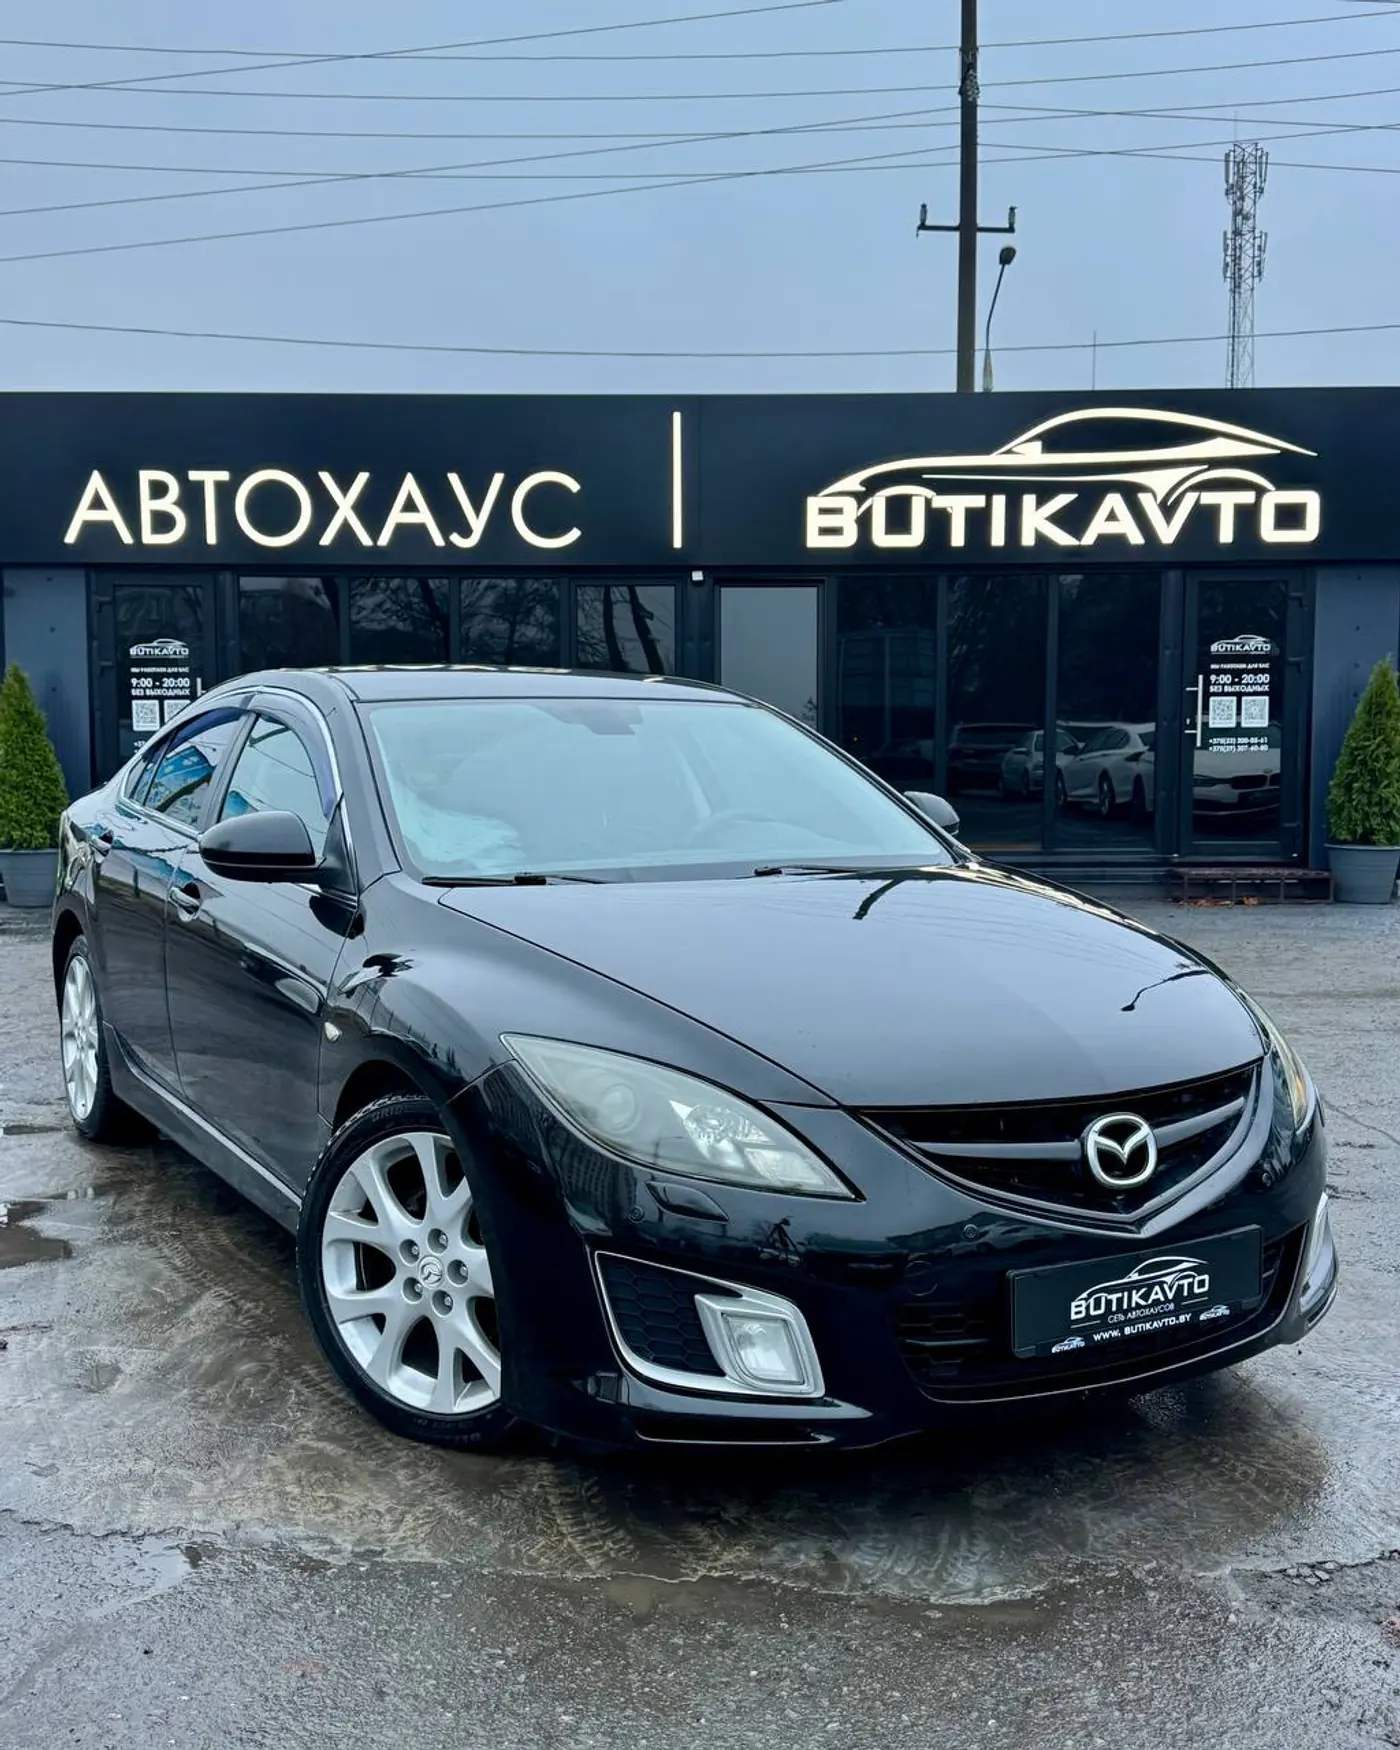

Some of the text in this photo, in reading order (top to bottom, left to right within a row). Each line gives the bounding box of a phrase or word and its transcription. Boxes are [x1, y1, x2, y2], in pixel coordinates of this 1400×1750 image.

[64, 469, 582, 549] АВТОХАУС
[806, 489, 1321, 549] BUTIKAVTO
[131, 677, 153, 688] 9:00
[162, 677, 190, 688] 20:00
[1209, 674, 1232, 684] 9:00
[1241, 673, 1270, 684] 20:00
[1070, 1274, 1210, 1320] BUTIKAVTO
[1107, 1302, 1175, 1324] СЕТЬ АВТОХАУСОВ
